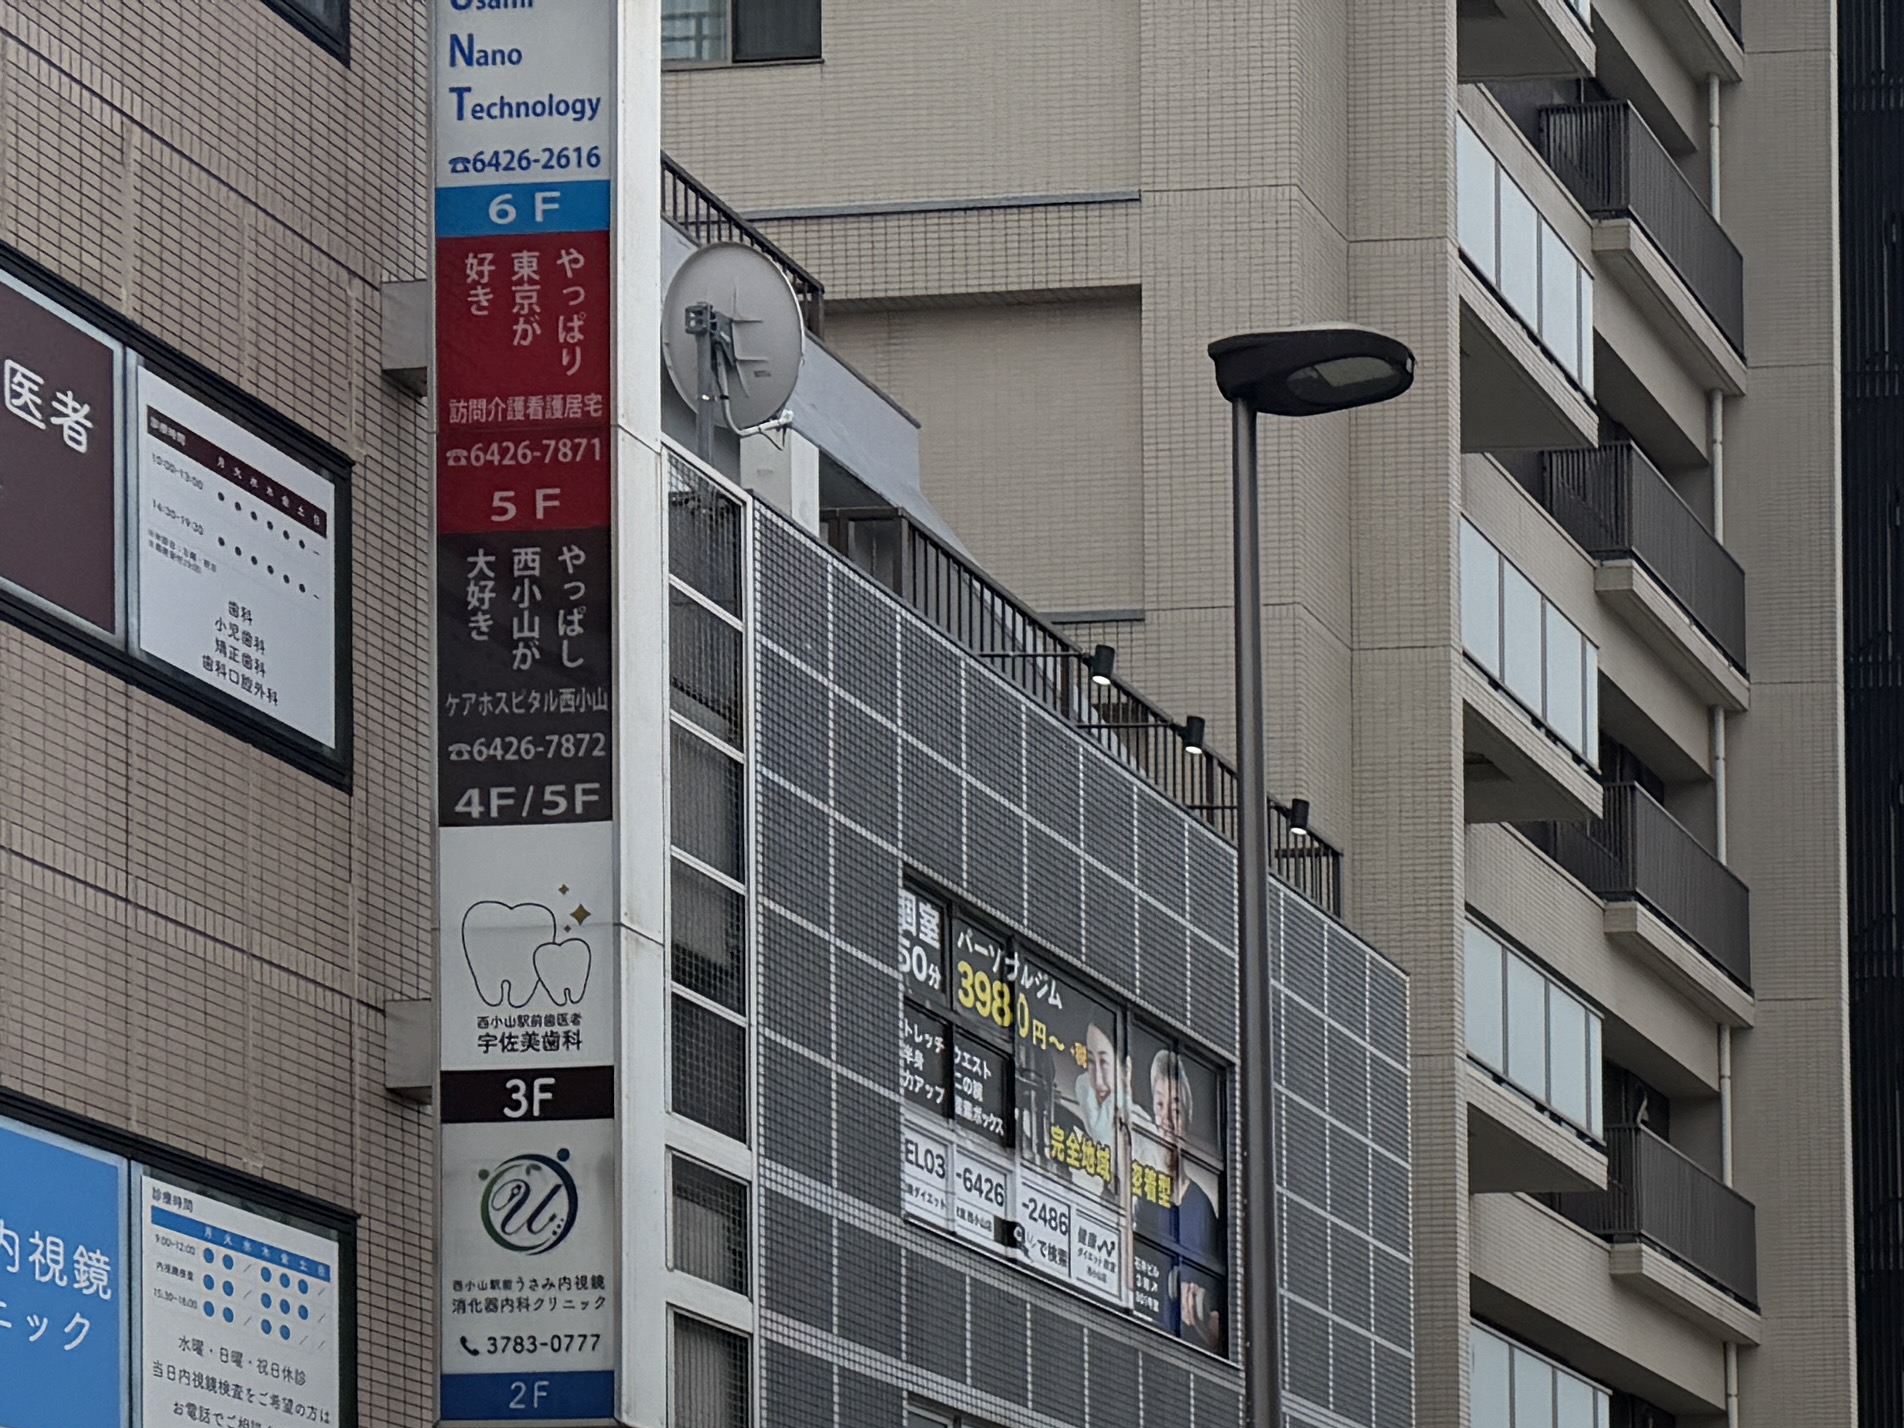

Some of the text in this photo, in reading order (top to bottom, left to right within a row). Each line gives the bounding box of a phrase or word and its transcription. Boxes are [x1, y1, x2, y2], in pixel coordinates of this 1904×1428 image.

[450, 33, 522, 67] Nano
[449, 86, 601, 121] Technology
[472, 146, 601, 173] 6426-2616
[465, 252, 495, 316] 好き
[511, 250, 541, 346] 東京が
[556, 248, 585, 376] やっぱり
[4, 358, 94, 453] 医者
[449, 393, 603, 424] 訪問介護看護居宅
[470, 438, 601, 466] 6426-7871
[467, 548, 496, 641] 大好き
[512, 547, 542, 671] 西小山が
[557, 545, 586, 668] やっぱし
[228, 600, 253, 626] 歯科
[215, 616, 266, 655] 小児歯科
[446, 688, 608, 717] ケアホスピタル西小山
[472, 733, 606, 762] 6426-7872
[454, 783, 600, 819] 4F/5F
[477, 1012, 582, 1029] 西小山駅前歯医者
[477, 1029, 582, 1054] 宇佐美歯科
[503, 1077, 556, 1119] 3F
[152, 1187, 193, 1213] 診療時間
[452, 1297, 605, 1314] 消化器内科クリニック
[487, 1334, 601, 1354] 3783-0777
[152, 1360, 331, 1425] 当日内視鏡検査をご希望の方は
[509, 1381, 550, 1409] 2F
